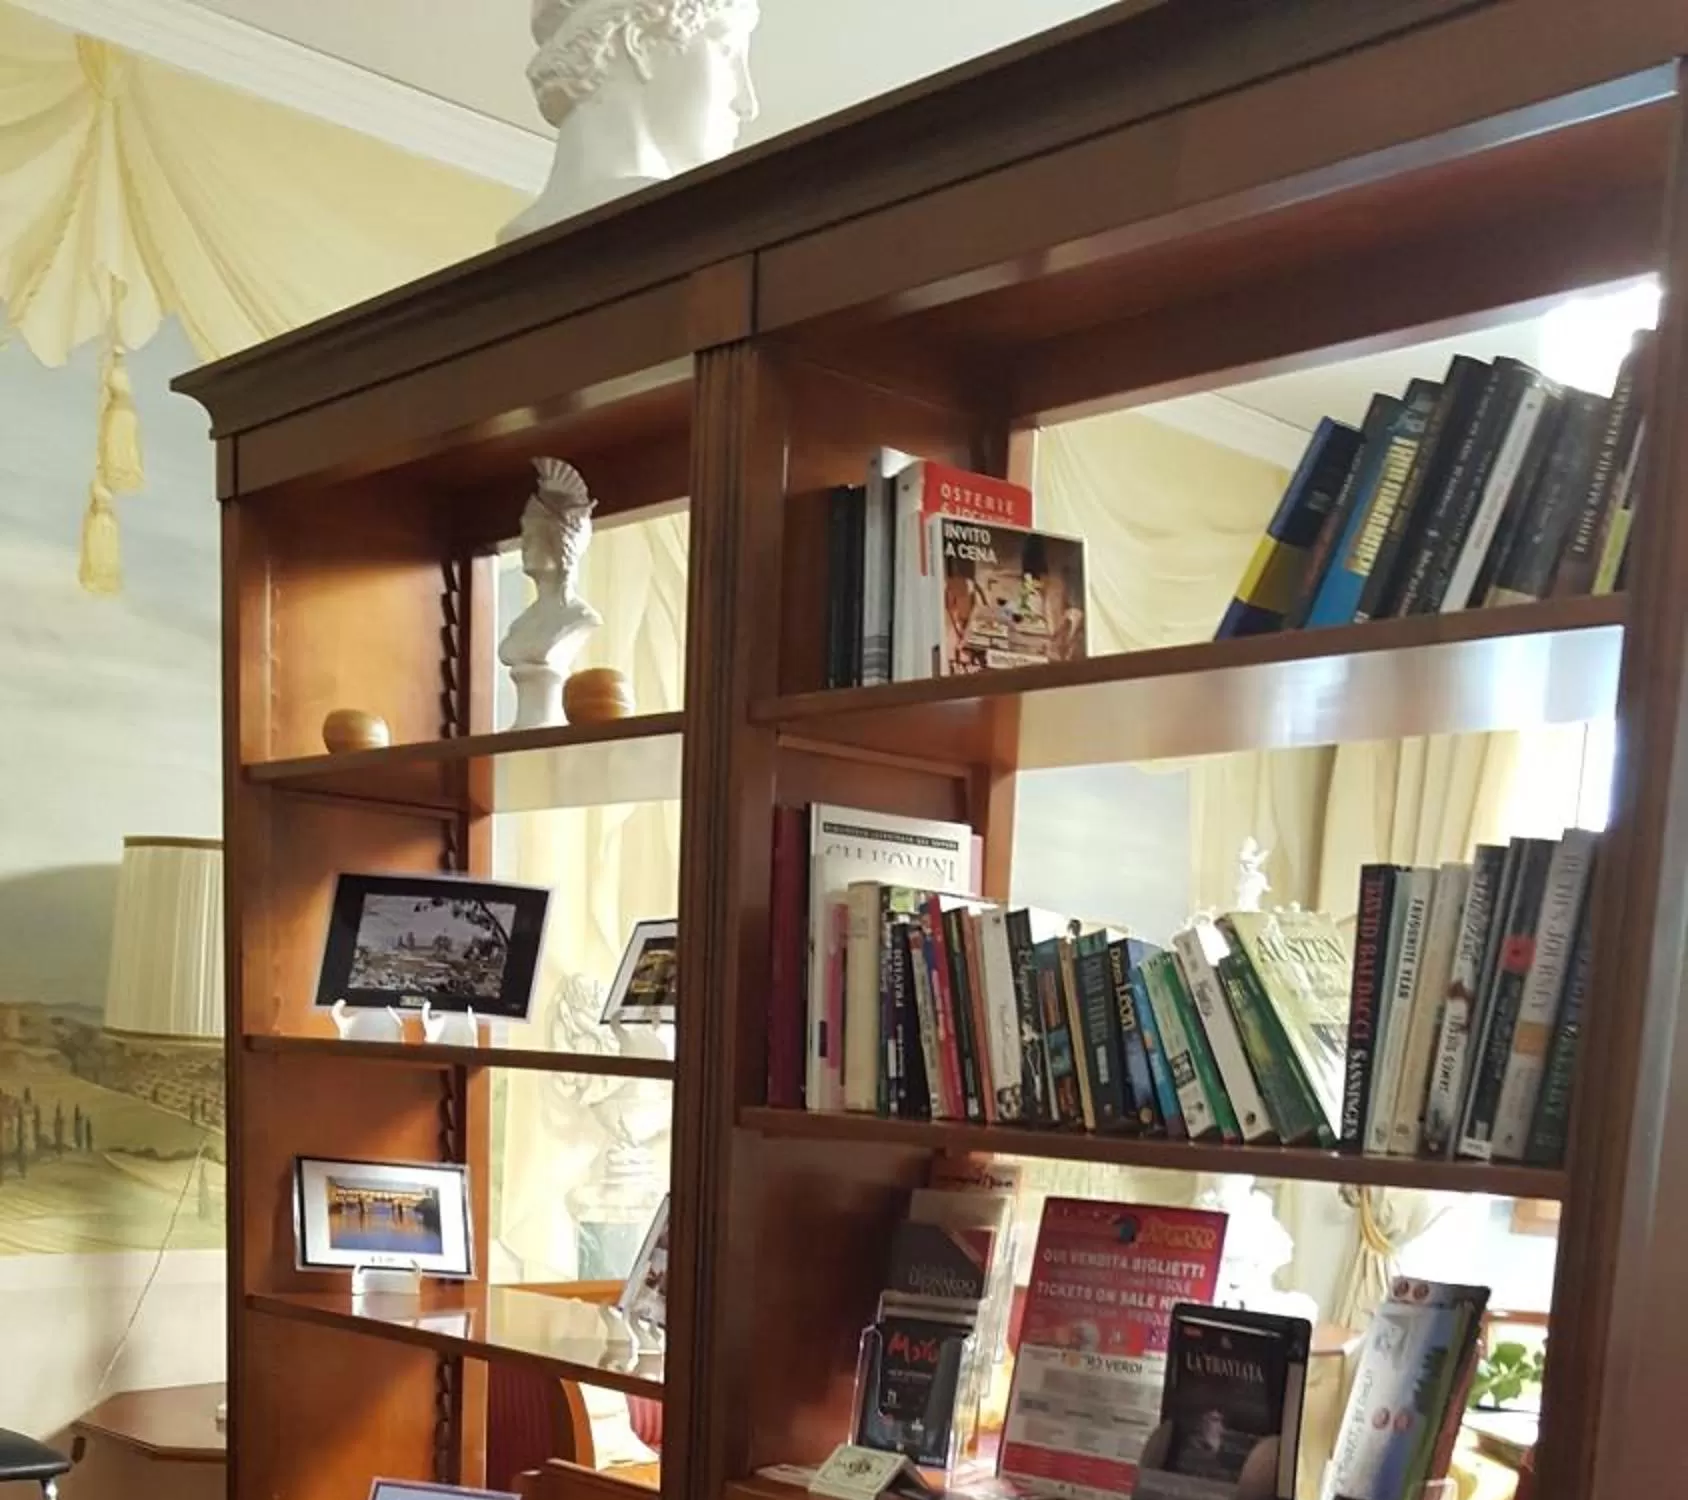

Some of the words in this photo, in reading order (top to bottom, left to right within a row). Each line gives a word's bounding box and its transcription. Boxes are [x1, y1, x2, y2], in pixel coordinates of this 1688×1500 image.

[940, 482, 1015, 516] OSTERIE
[944, 523, 991, 545] INVITO
[945, 543, 956, 557] A
[958, 543, 998, 564] CENA
[1359, 880, 1385, 937] DAVID
[1402, 899, 1425, 962] FAVOURITE
[1257, 936, 1347, 964] AUSTEN
[1351, 943, 1377, 1041] BALDACCI
[1398, 969, 1413, 999] YEAR
[1116, 984, 1136, 1032] Leon
[1070, 1252, 1128, 1269] VENDITA
[1131, 1257, 1206, 1278] BIGLIETTI
[1036, 1281, 1092, 1300] TICKETS
[1095, 1289, 1116, 1303] ON
[1119, 1291, 1155, 1308] SALE
